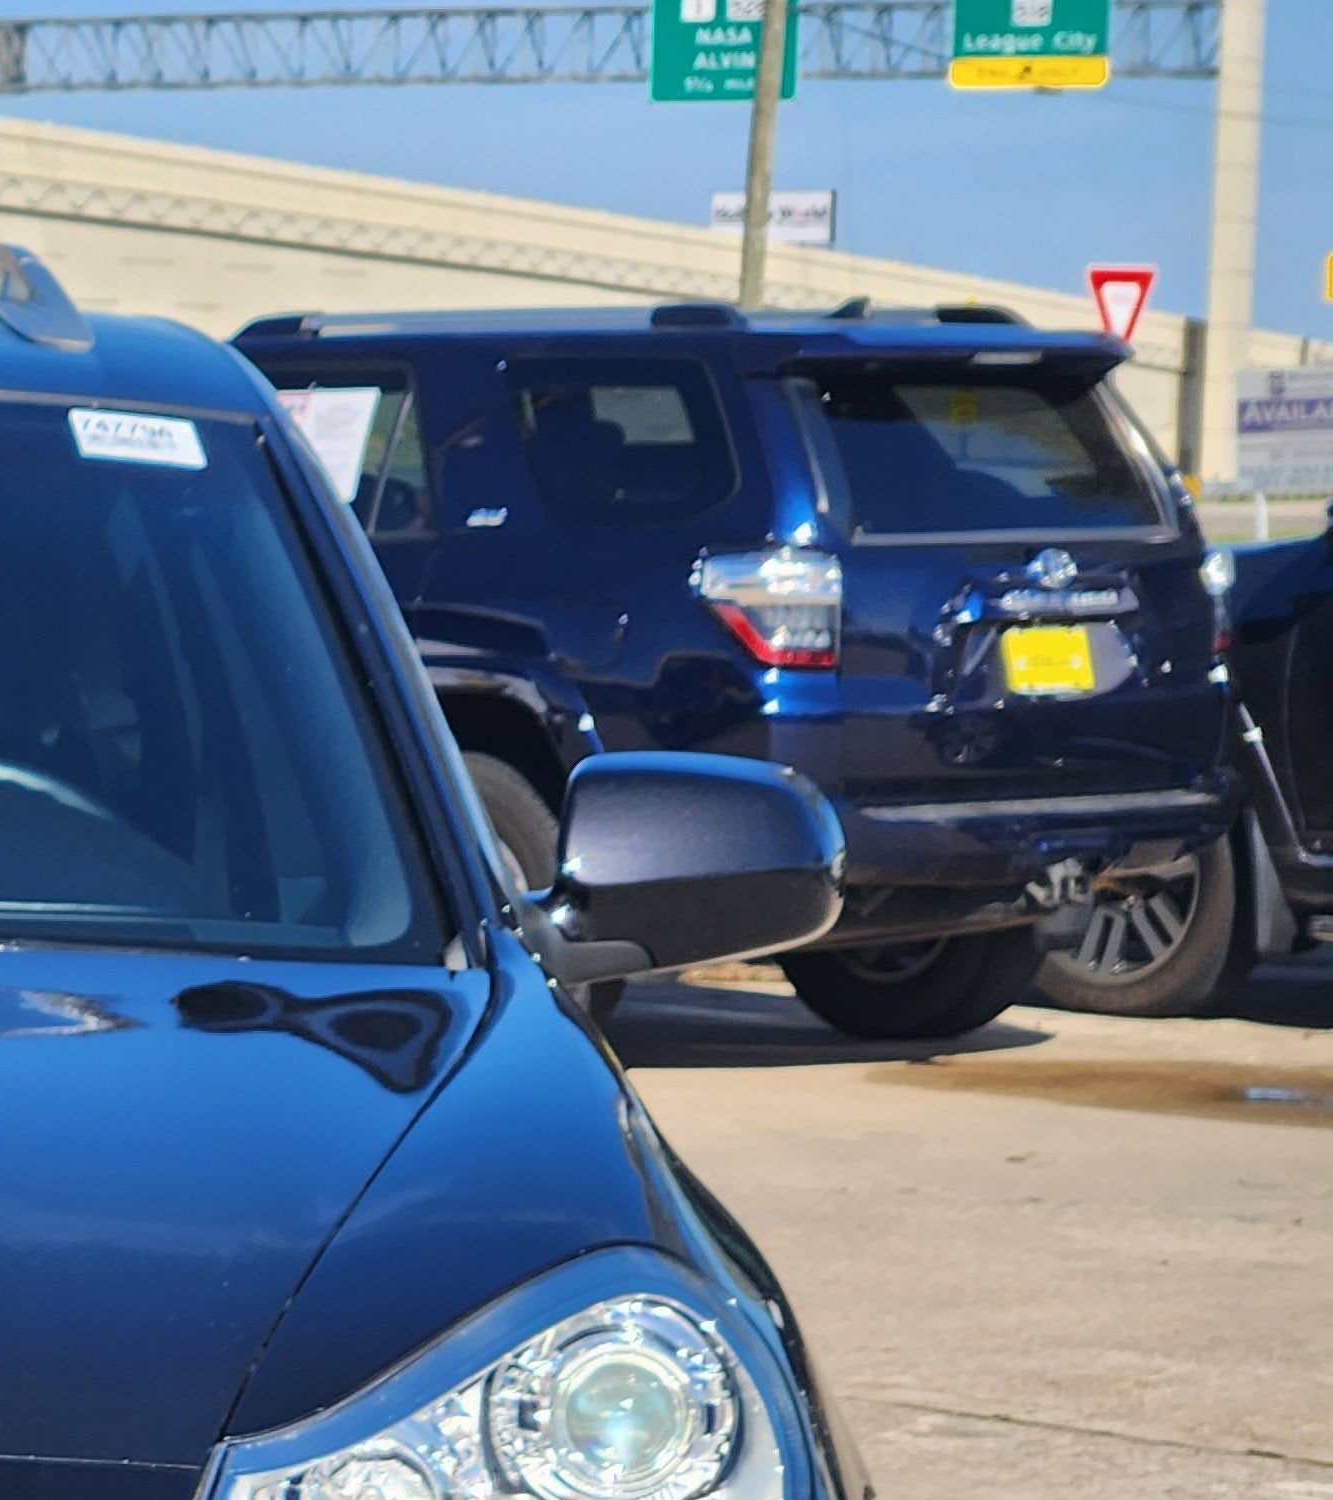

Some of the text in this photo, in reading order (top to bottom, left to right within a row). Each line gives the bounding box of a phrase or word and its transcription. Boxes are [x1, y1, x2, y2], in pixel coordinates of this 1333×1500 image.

[695, 26, 753, 45] NASA
[962, 30, 1097, 54] League City
